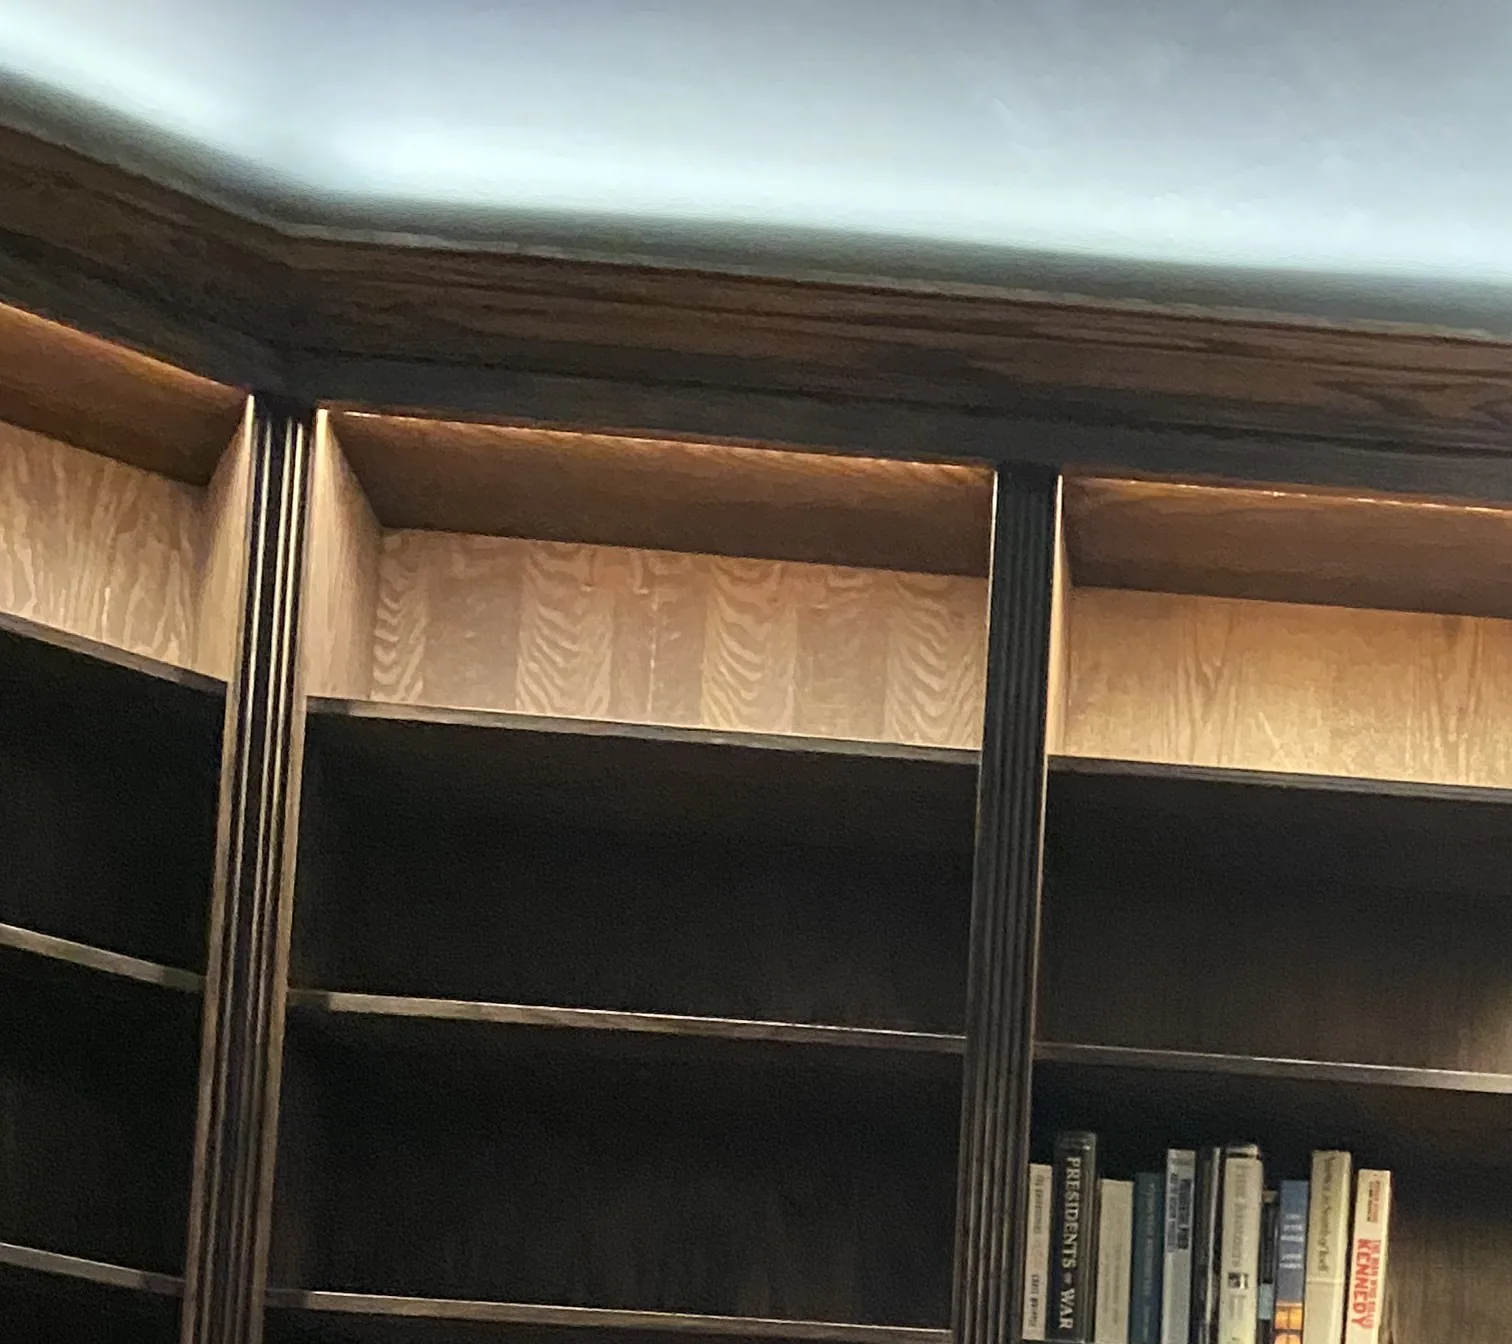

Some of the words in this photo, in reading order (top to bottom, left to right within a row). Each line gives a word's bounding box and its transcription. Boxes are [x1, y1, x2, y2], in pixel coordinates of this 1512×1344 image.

[1061, 1156, 1082, 1268] PRESIDENTS
[1058, 1286, 1075, 1329] WAR
[1349, 1237, 1373, 1328] KENNEDY
